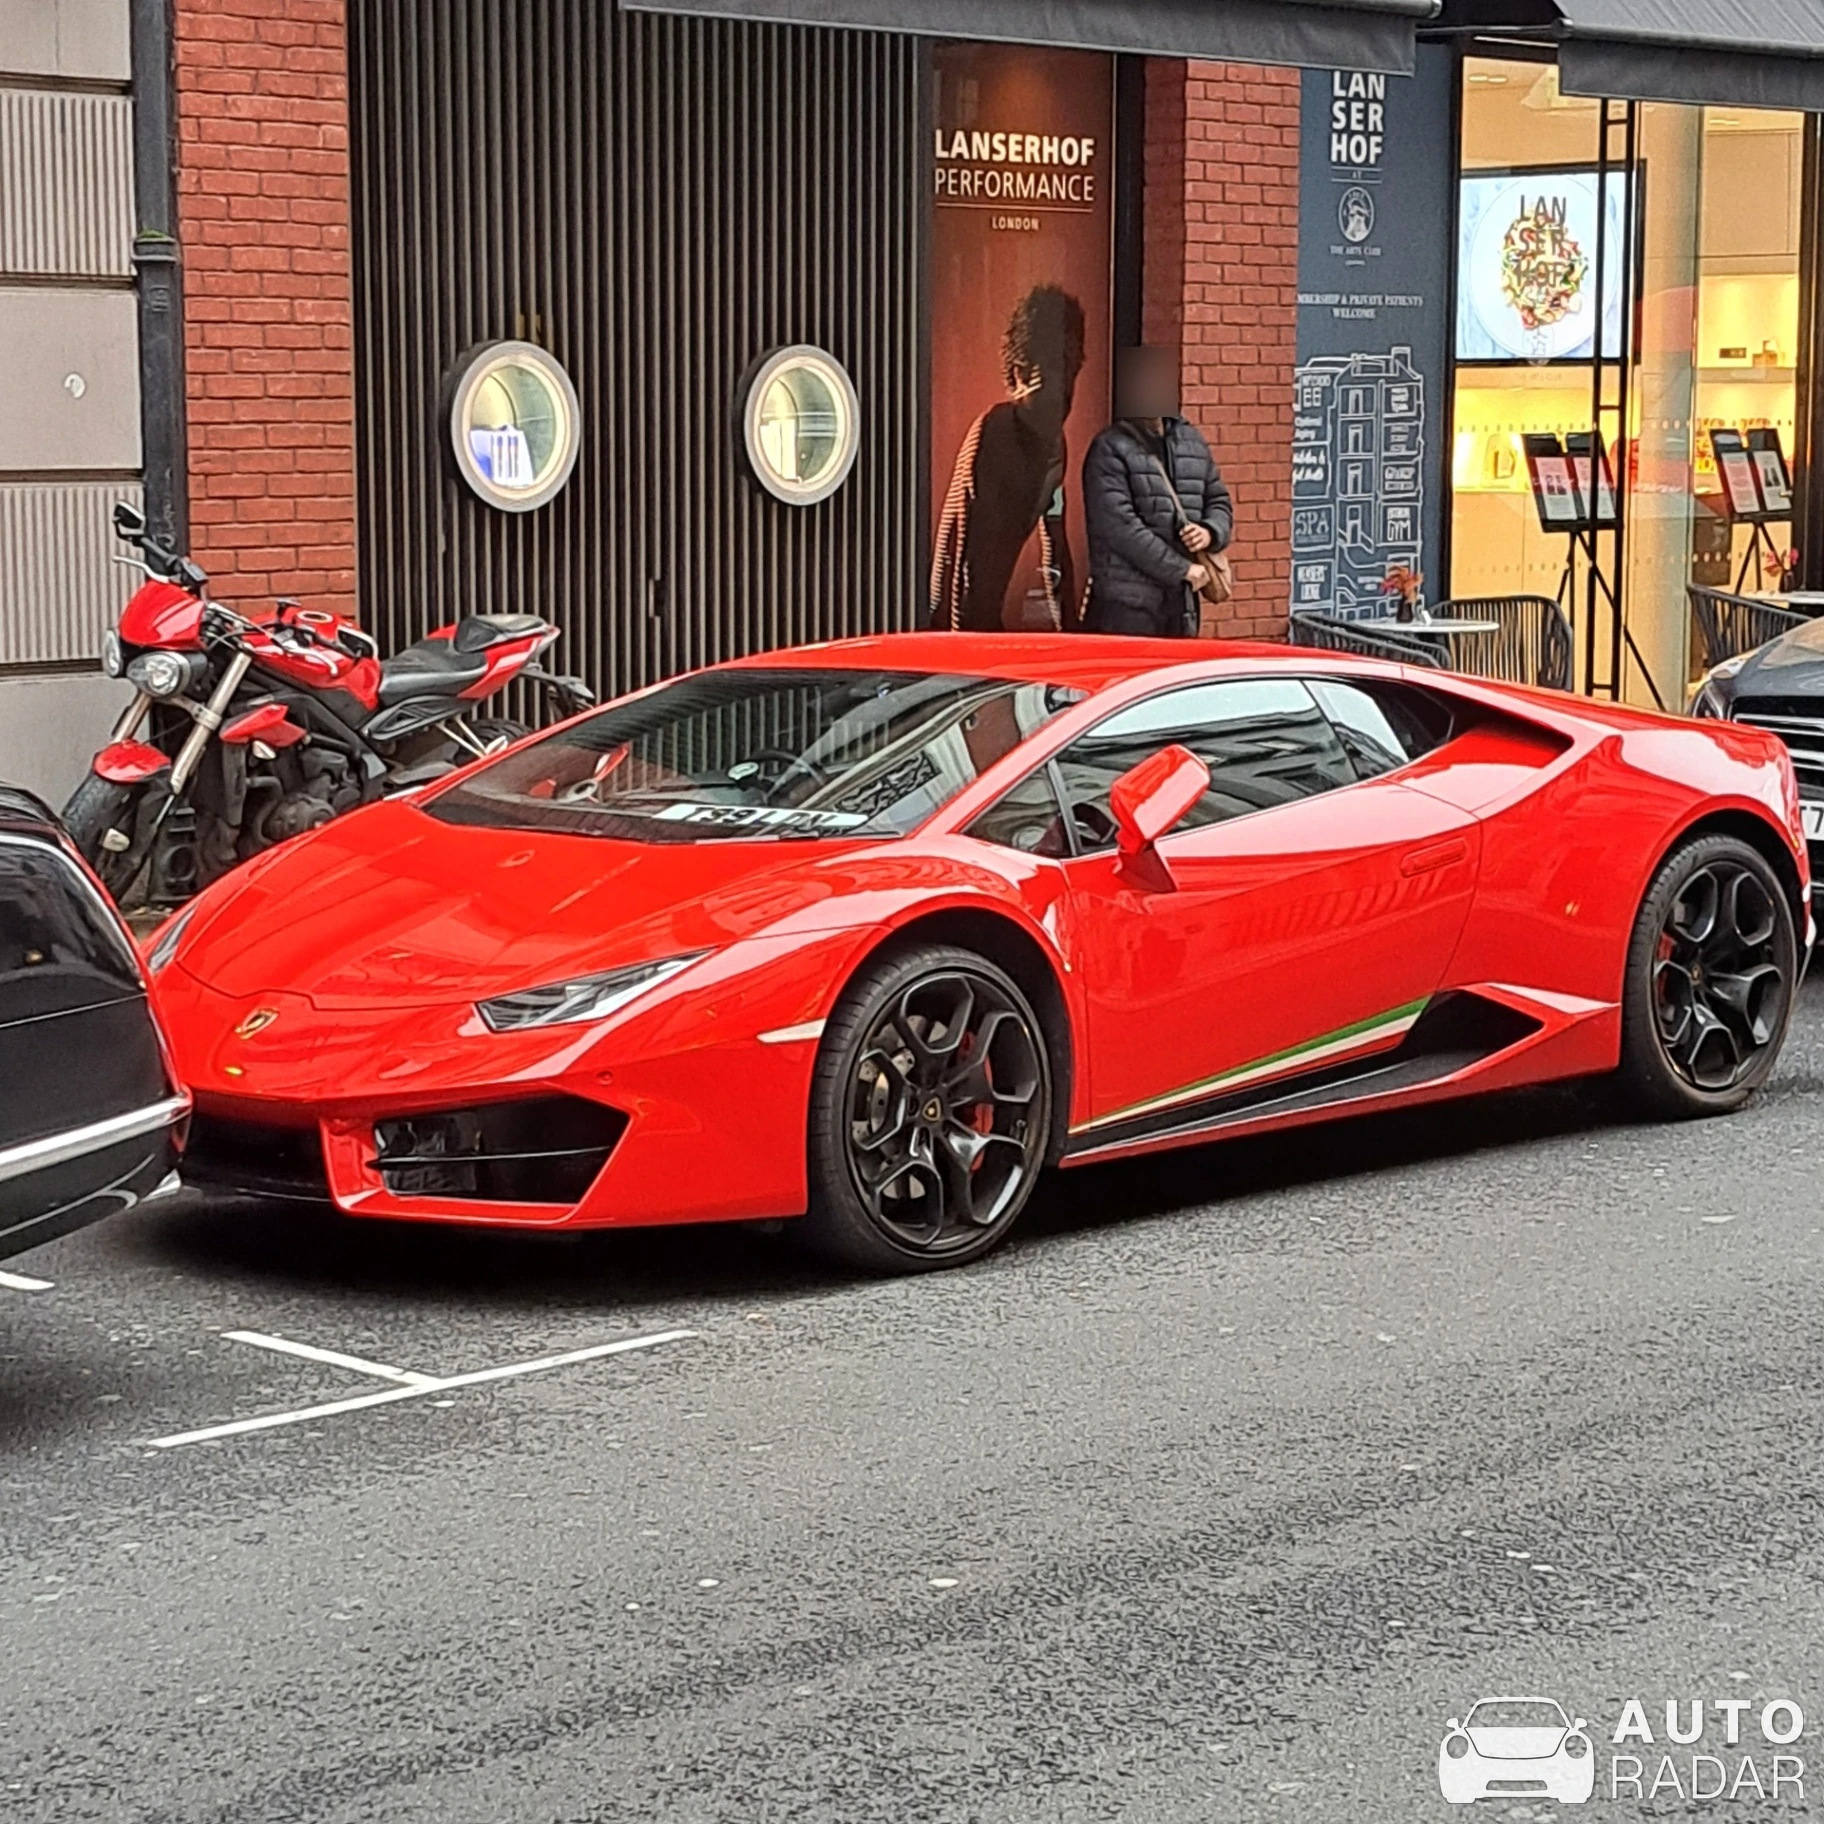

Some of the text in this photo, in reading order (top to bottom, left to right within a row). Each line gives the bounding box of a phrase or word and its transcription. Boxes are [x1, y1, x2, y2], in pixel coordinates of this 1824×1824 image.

[1333, 70, 1385, 100] LAN
[1332, 100, 1383, 132] SER
[935, 129, 1095, 166] LANSERHOF
[1331, 132, 1382, 164] HOF
[935, 168, 1095, 201] PERFORMANCE
[991, 216, 1040, 231] LONDON
[1519, 194, 1567, 226] LAN
[1332, 307, 1376, 319] WELCOME
[1295, 511, 1329, 535] SPA
